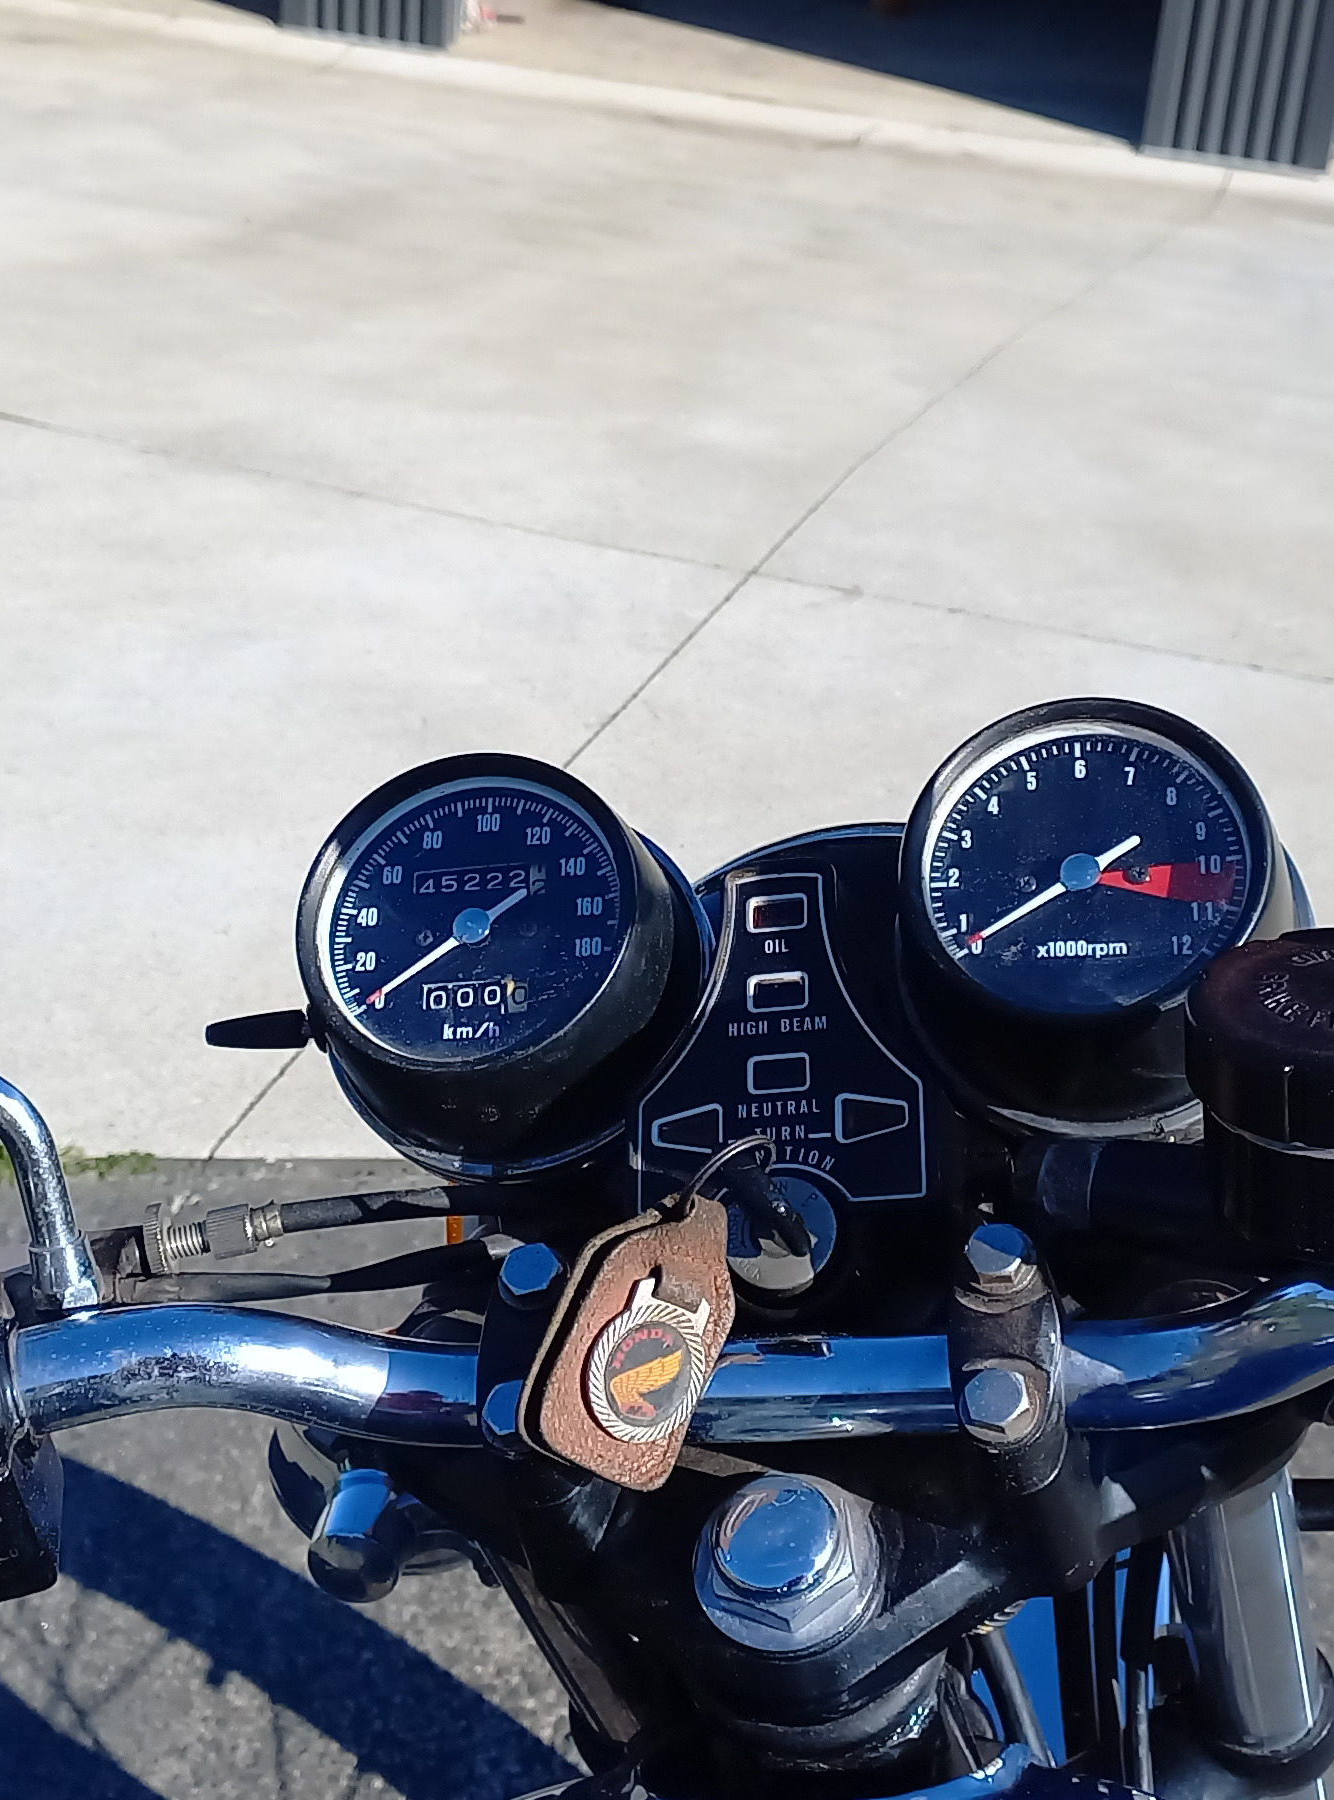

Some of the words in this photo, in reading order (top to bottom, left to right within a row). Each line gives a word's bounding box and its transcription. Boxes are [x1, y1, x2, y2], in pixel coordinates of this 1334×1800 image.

[1074, 759, 1087, 779] 6
[1124, 767, 1136, 786] 7
[1027, 771, 1038, 791] 5
[986, 795, 1000, 816] 4
[1166, 787, 1177, 806] 8
[476, 814, 501, 832] 100
[1195, 822, 1206, 841] 9
[422, 830, 443, 850] 80
[526, 826, 551, 845] 120
[961, 829, 972, 849] 3
[559, 857, 586, 876] 140
[1198, 855, 1221, 874] 10
[382, 865, 403, 884] 60
[947, 868, 960, 888] 2
[576, 897, 602, 916] 160
[1190, 902, 1214, 921] 11
[356, 907, 378, 927] 40
[959, 913, 968, 933] 1
[575, 938, 602, 957] 180
[764, 938, 789, 954] OIL
[1036, 940, 1128, 959] x1000rpm
[1171, 936, 1193, 956] 12
[354, 951, 376, 971] 20
[442, 1021, 500, 1040] km/h
[728, 1020, 768, 1037] HIGH
[780, 1015, 828, 1033] BEAM
[738, 1099, 821, 1119] NEUTRAL
[612, 1328, 674, 1369] HONDA
